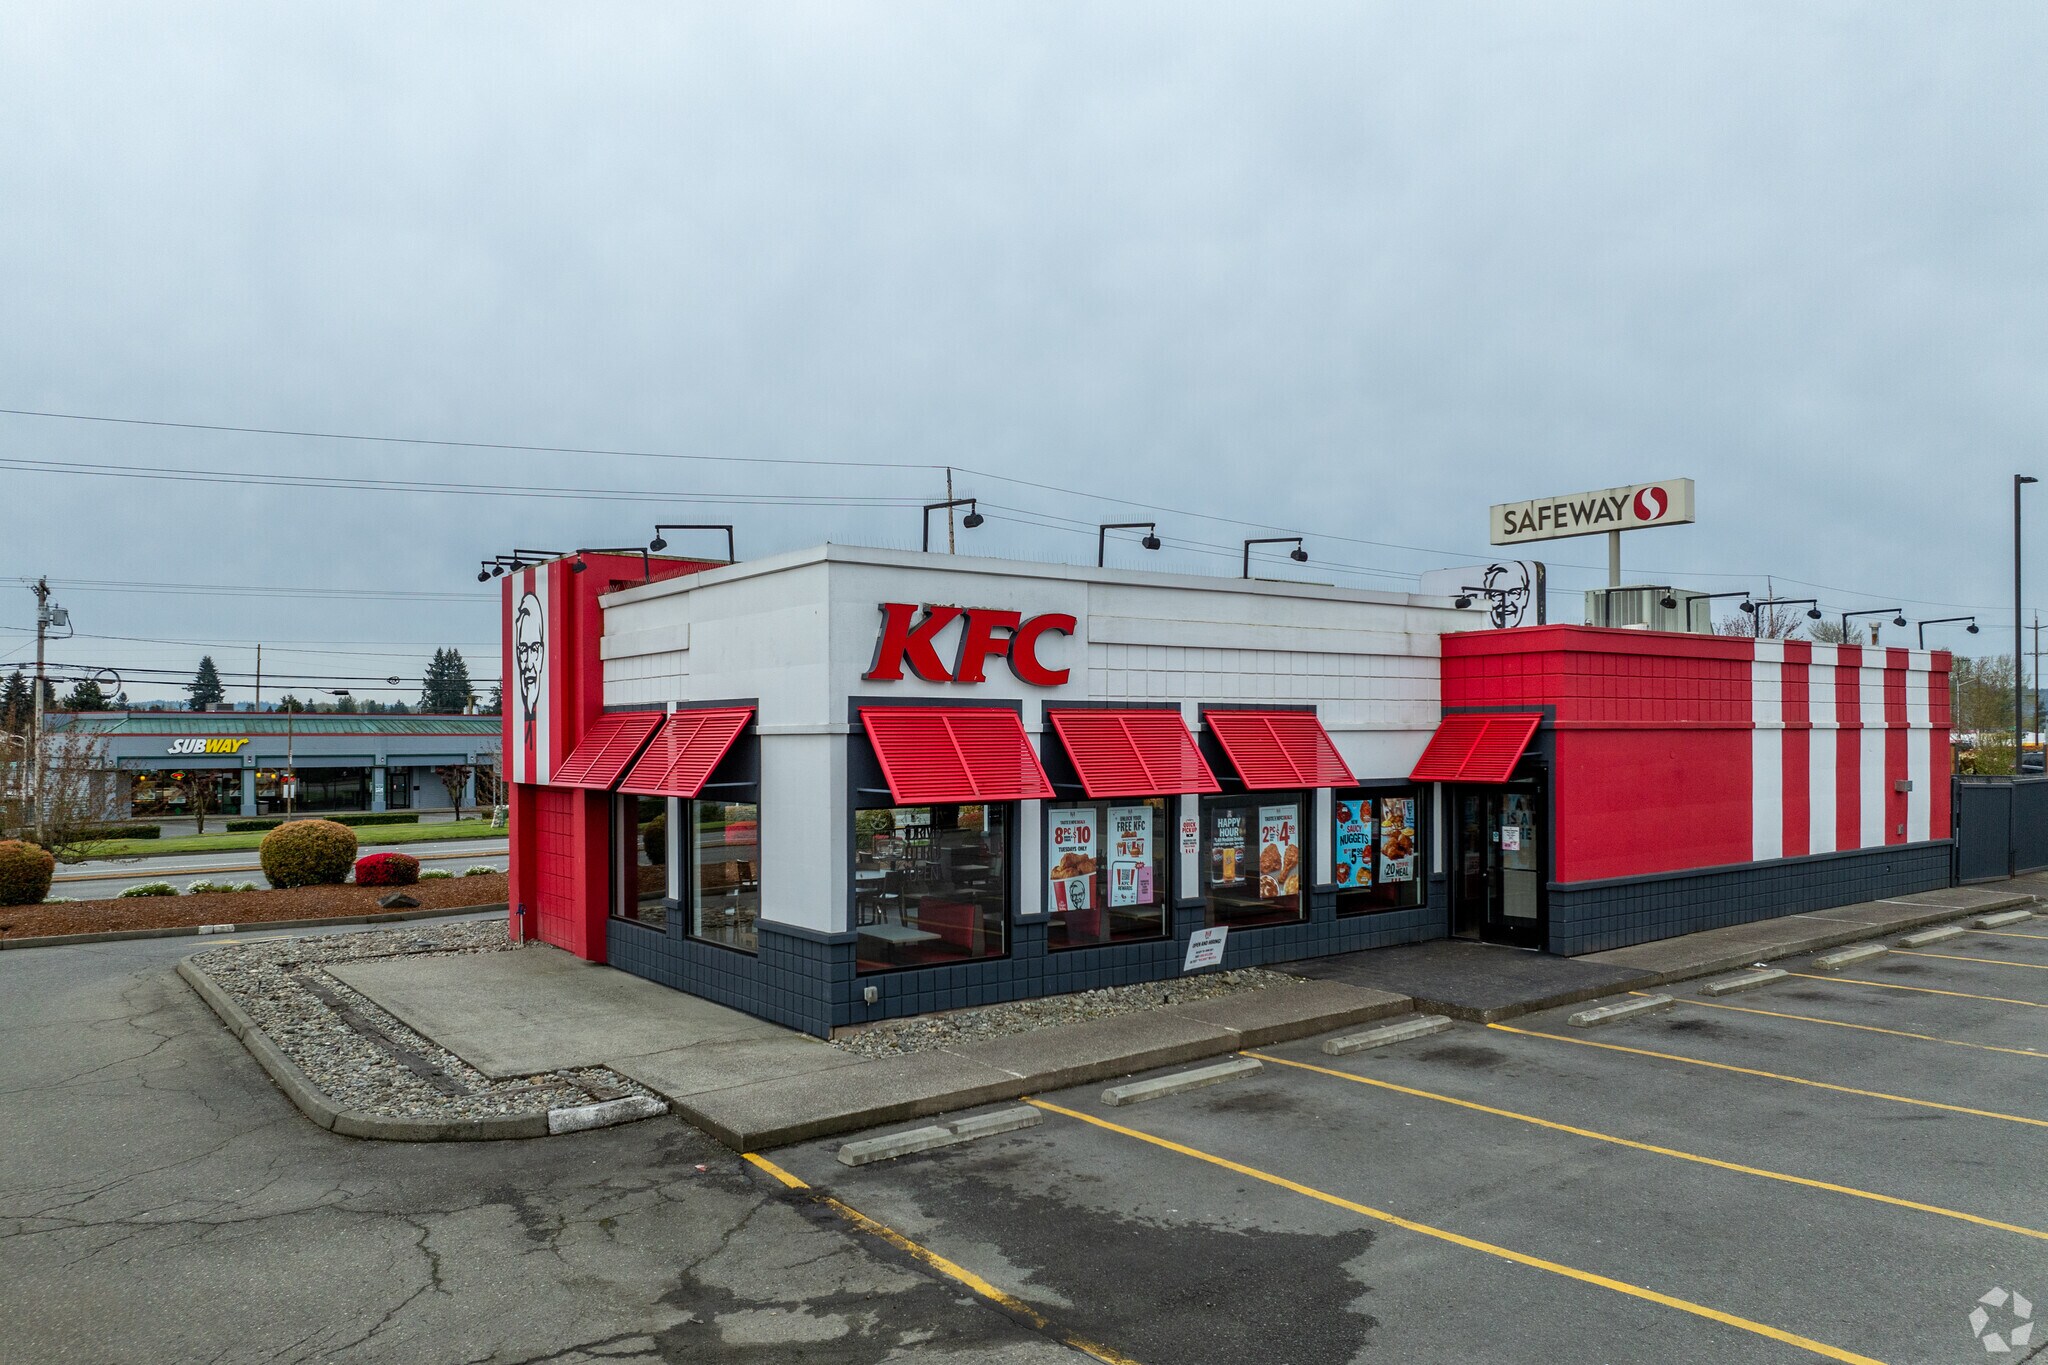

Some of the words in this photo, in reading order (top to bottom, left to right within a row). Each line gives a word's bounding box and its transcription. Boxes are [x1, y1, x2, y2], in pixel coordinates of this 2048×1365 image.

[1503, 494, 1631, 535] SAFEWAY
[861, 602, 1077, 687] KFC
[167, 738, 249, 754] SUBWAY
[1117, 822, 1131, 832] FREE
[1134, 821, 1145, 830] KFC
[1217, 818, 1241, 828] HAPPY
[1347, 825, 1362, 833] SAUCY
[1055, 827, 1063, 844] 8
[1219, 827, 1239, 837] HOUR
[1263, 826, 1269, 842] 2
[1340, 833, 1369, 846] NUGGETS
[1396, 866, 1409, 877] MEAL
